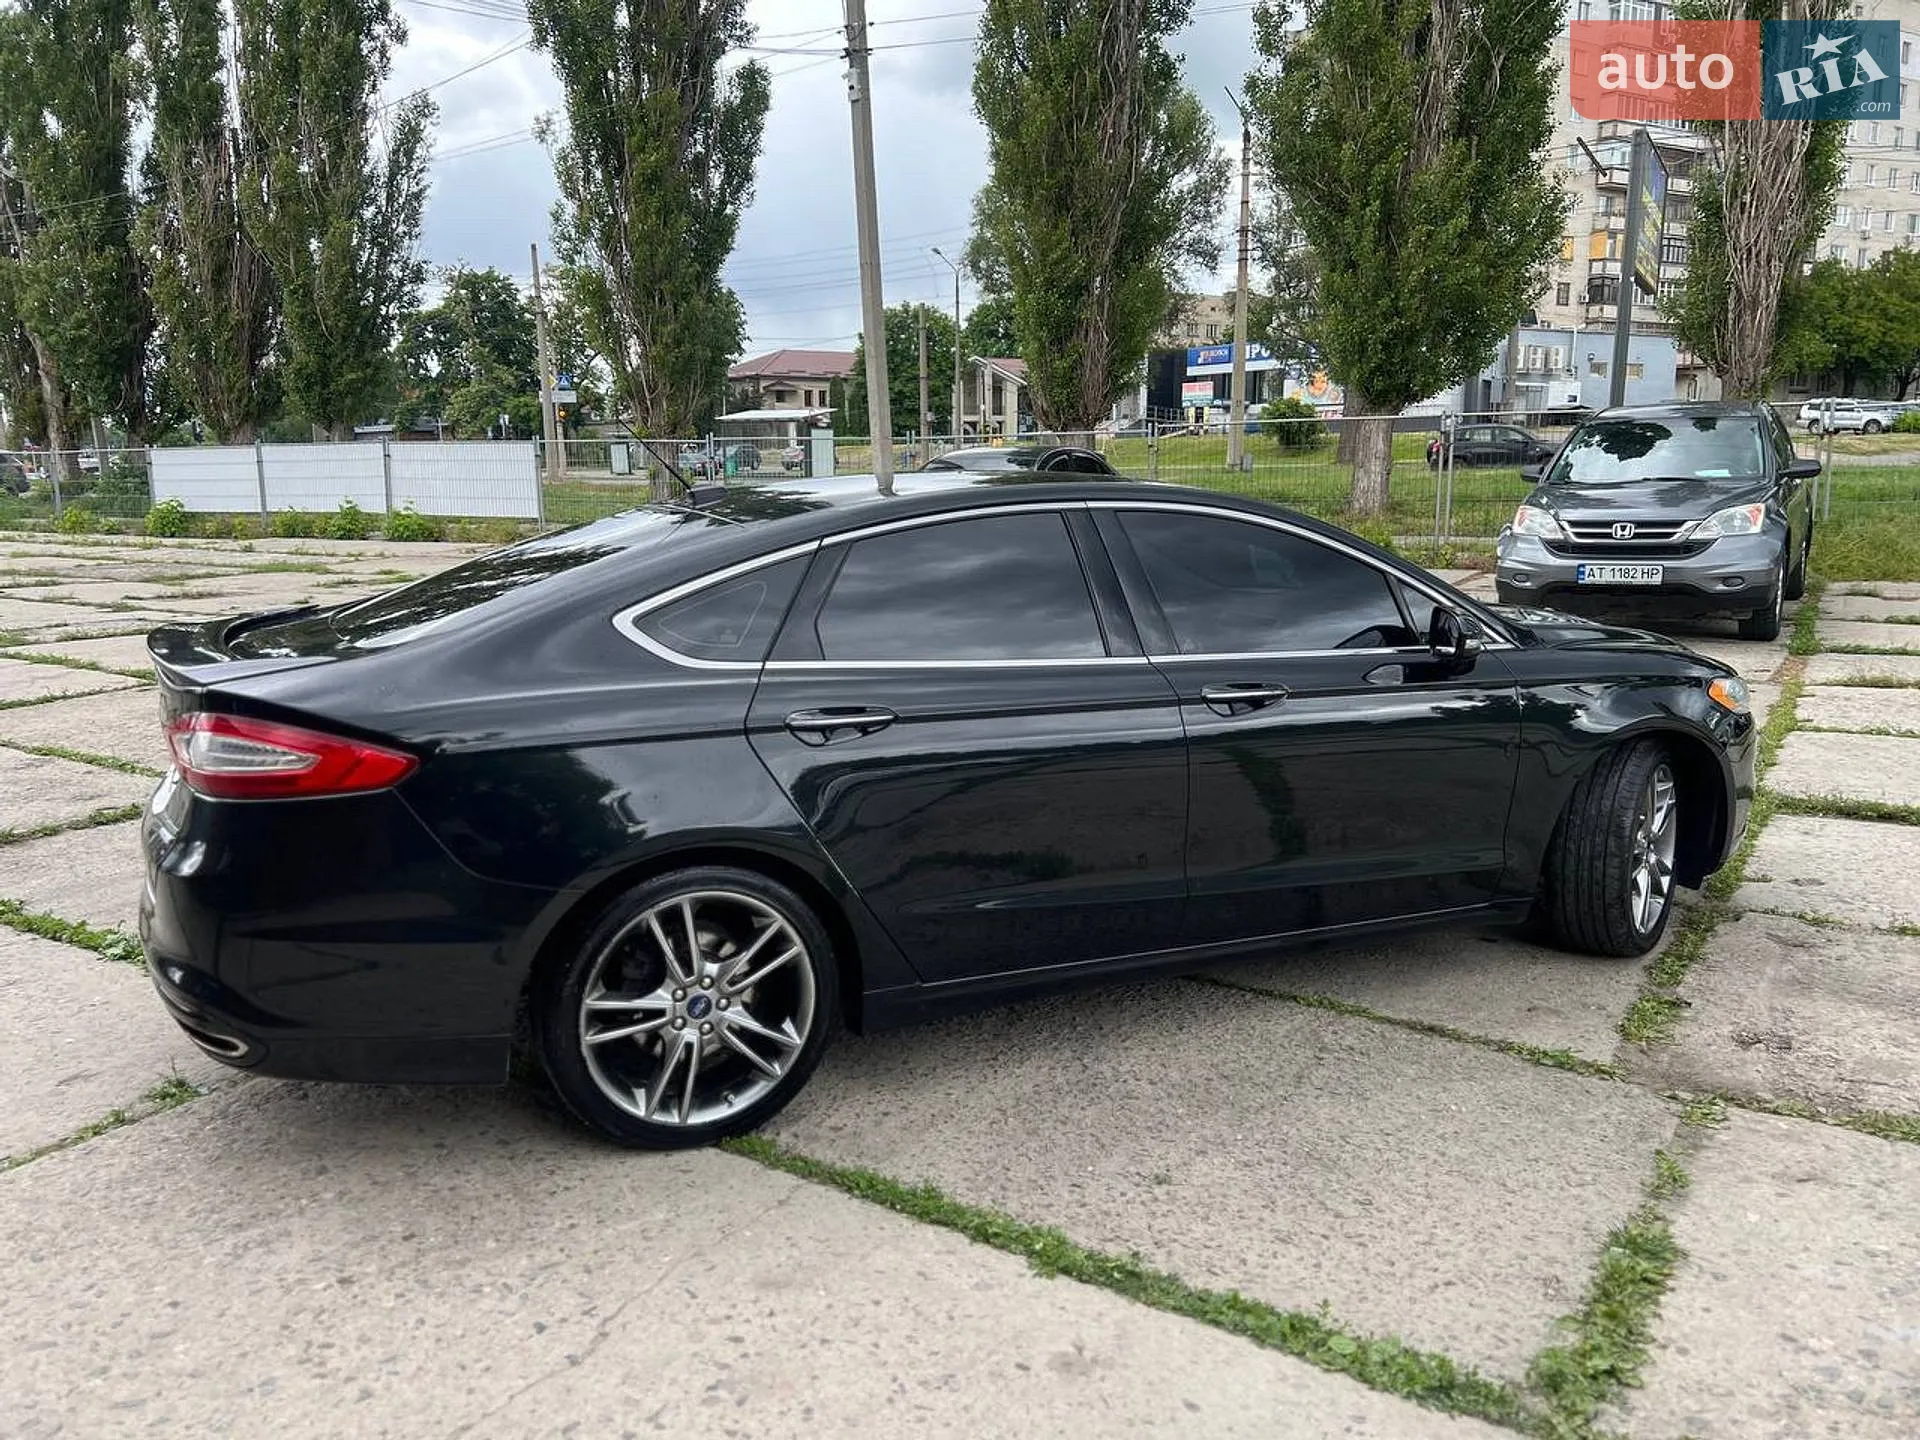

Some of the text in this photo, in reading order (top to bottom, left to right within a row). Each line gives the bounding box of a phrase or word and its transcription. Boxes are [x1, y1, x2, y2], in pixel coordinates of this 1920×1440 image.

[1587, 567, 1660, 578] AT 1182 HP
